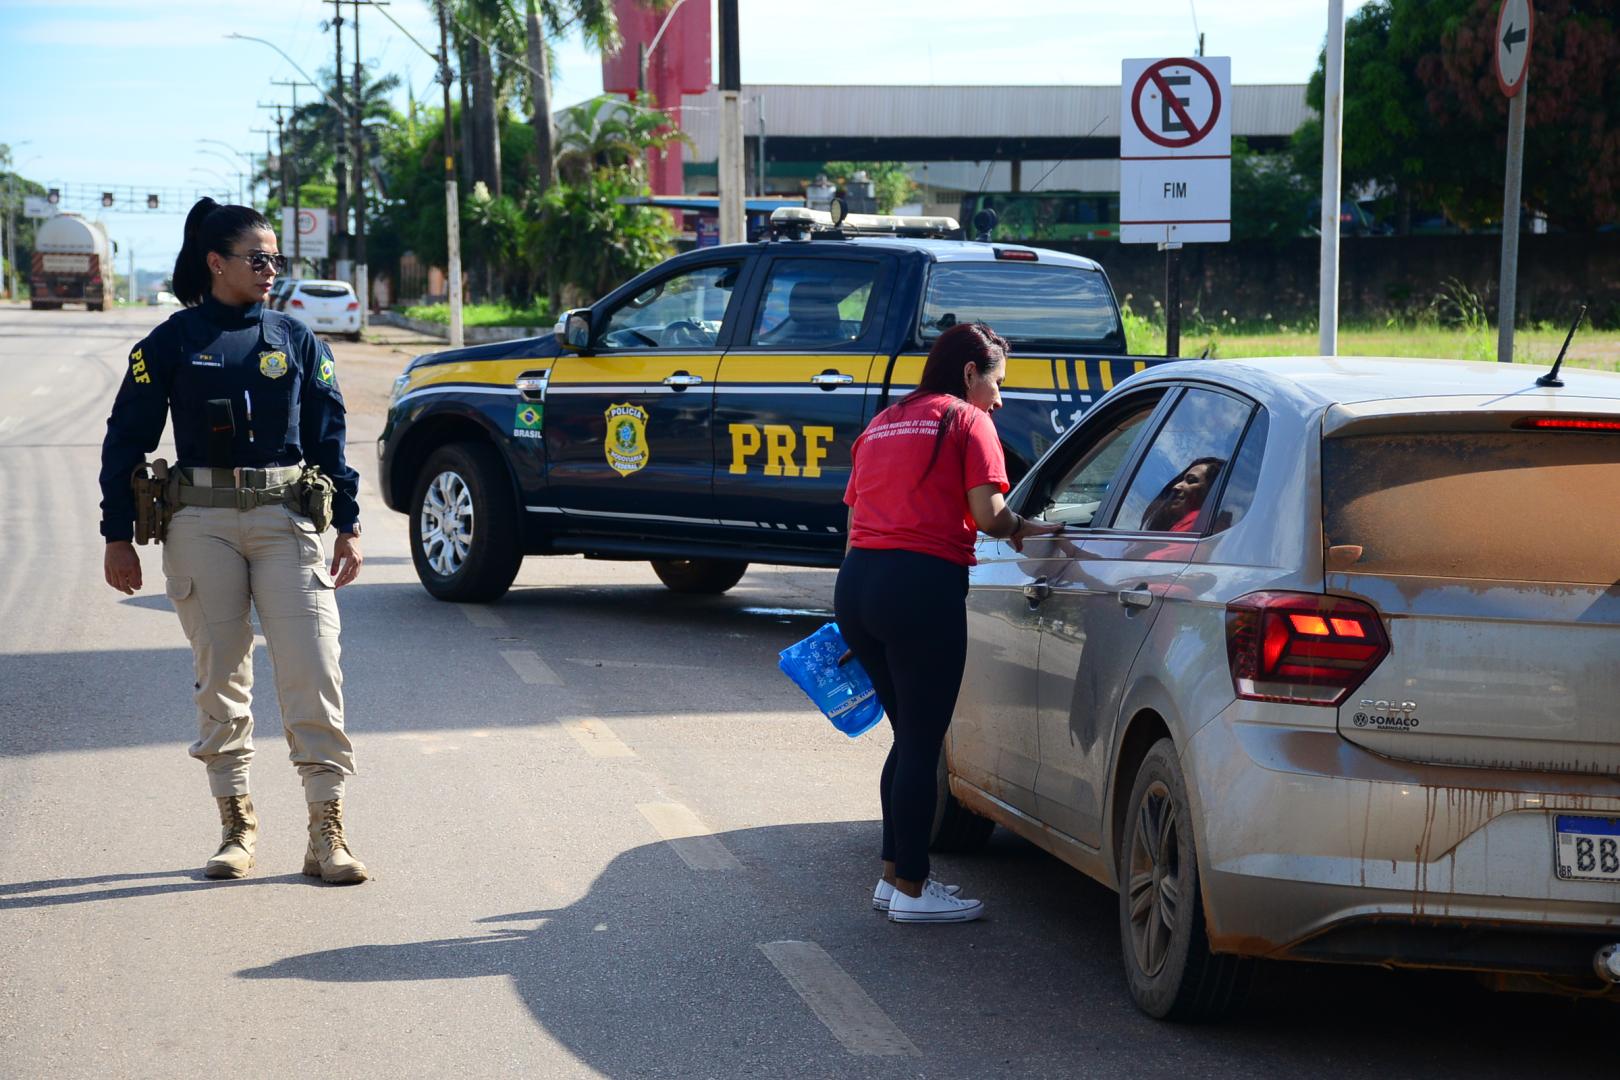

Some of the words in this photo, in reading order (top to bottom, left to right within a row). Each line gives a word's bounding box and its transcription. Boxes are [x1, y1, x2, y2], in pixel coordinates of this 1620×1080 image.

[1163, 182, 1187, 198] FIM
[131, 348, 151, 383] PRF
[513, 429, 542, 439] BRASIL
[728, 424, 834, 478] PRF
[1360, 699, 1417, 713] POLO
[1369, 715, 1419, 727] SOMACO
[1561, 866, 1572, 876] BR
